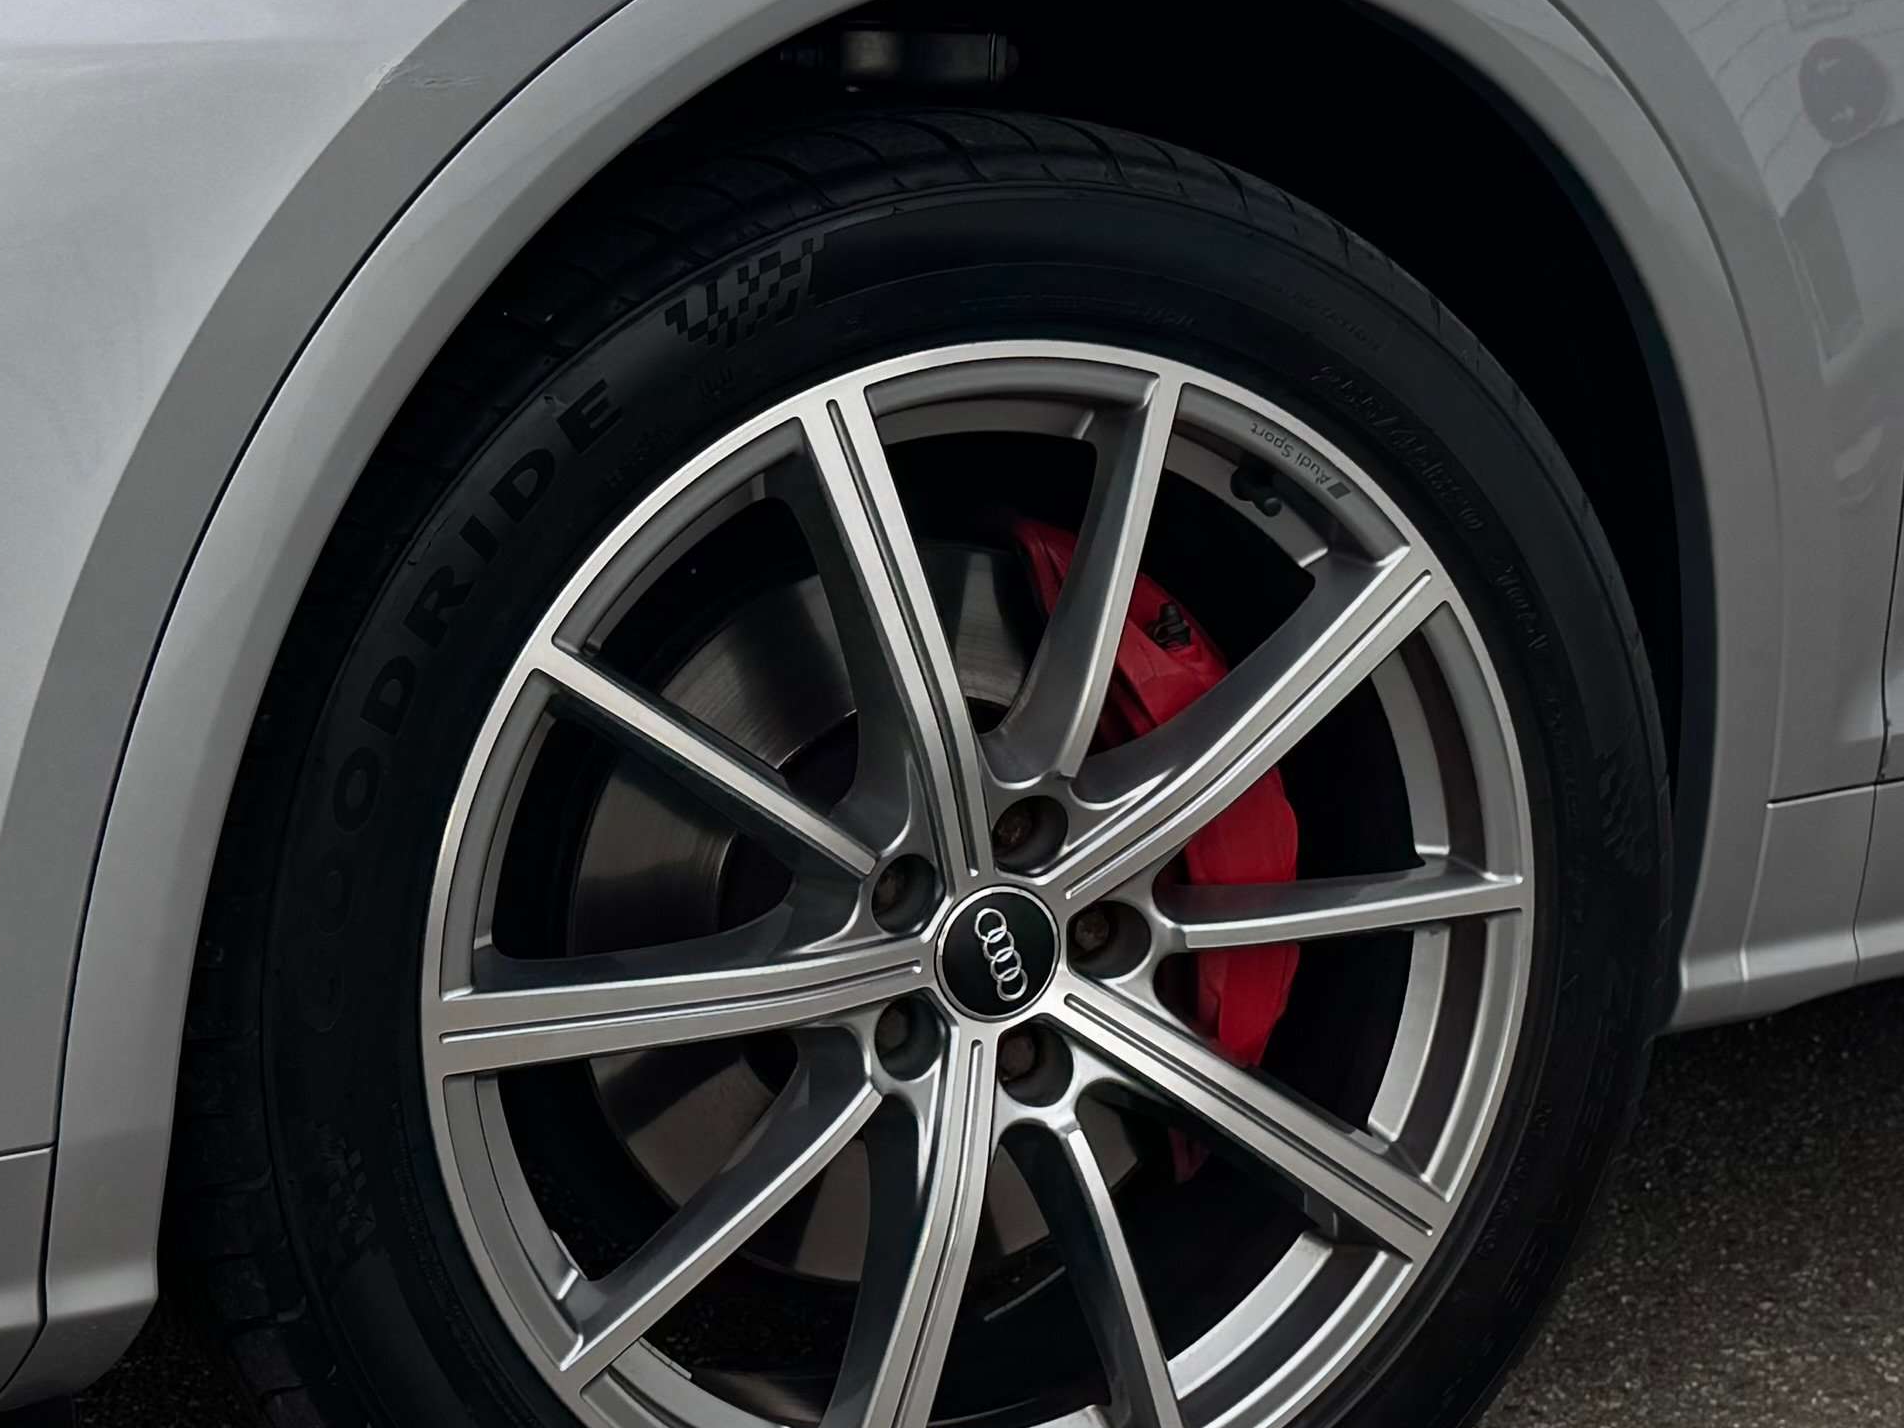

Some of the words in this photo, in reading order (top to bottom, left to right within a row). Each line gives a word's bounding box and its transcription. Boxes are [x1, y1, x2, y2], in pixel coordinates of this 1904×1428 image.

[1250, 422, 1295, 458] Sport
[1296, 453, 1332, 485] Audi
[308, 378, 623, 1034] GOODRIDE
